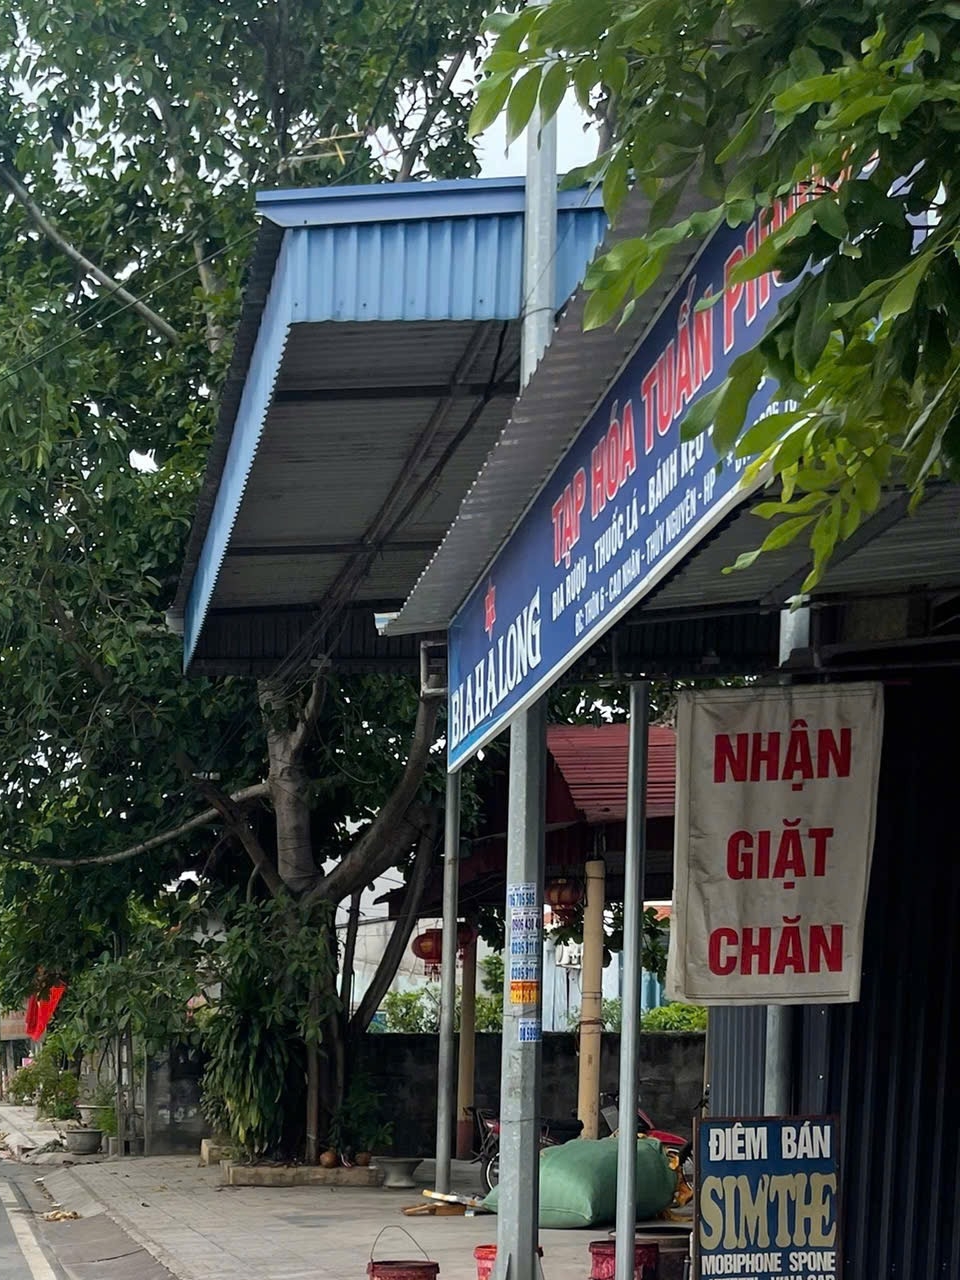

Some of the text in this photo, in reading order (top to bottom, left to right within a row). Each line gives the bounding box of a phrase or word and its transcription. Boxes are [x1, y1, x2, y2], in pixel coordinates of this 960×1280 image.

[551, 467, 587, 569] TẠP
[626, 488, 639, 540] LÁ
[648, 457, 678, 515] BÁNH
[703, 467, 716, 505] HP
[713, 719, 852, 791] NHẬN
[727, 818, 835, 889] GIẶT
[708, 915, 844, 976] CHĂN
[781, 1121, 831, 1160] BÁN
[701, 1251, 836, 1276] MOBIPHONE SPONE
